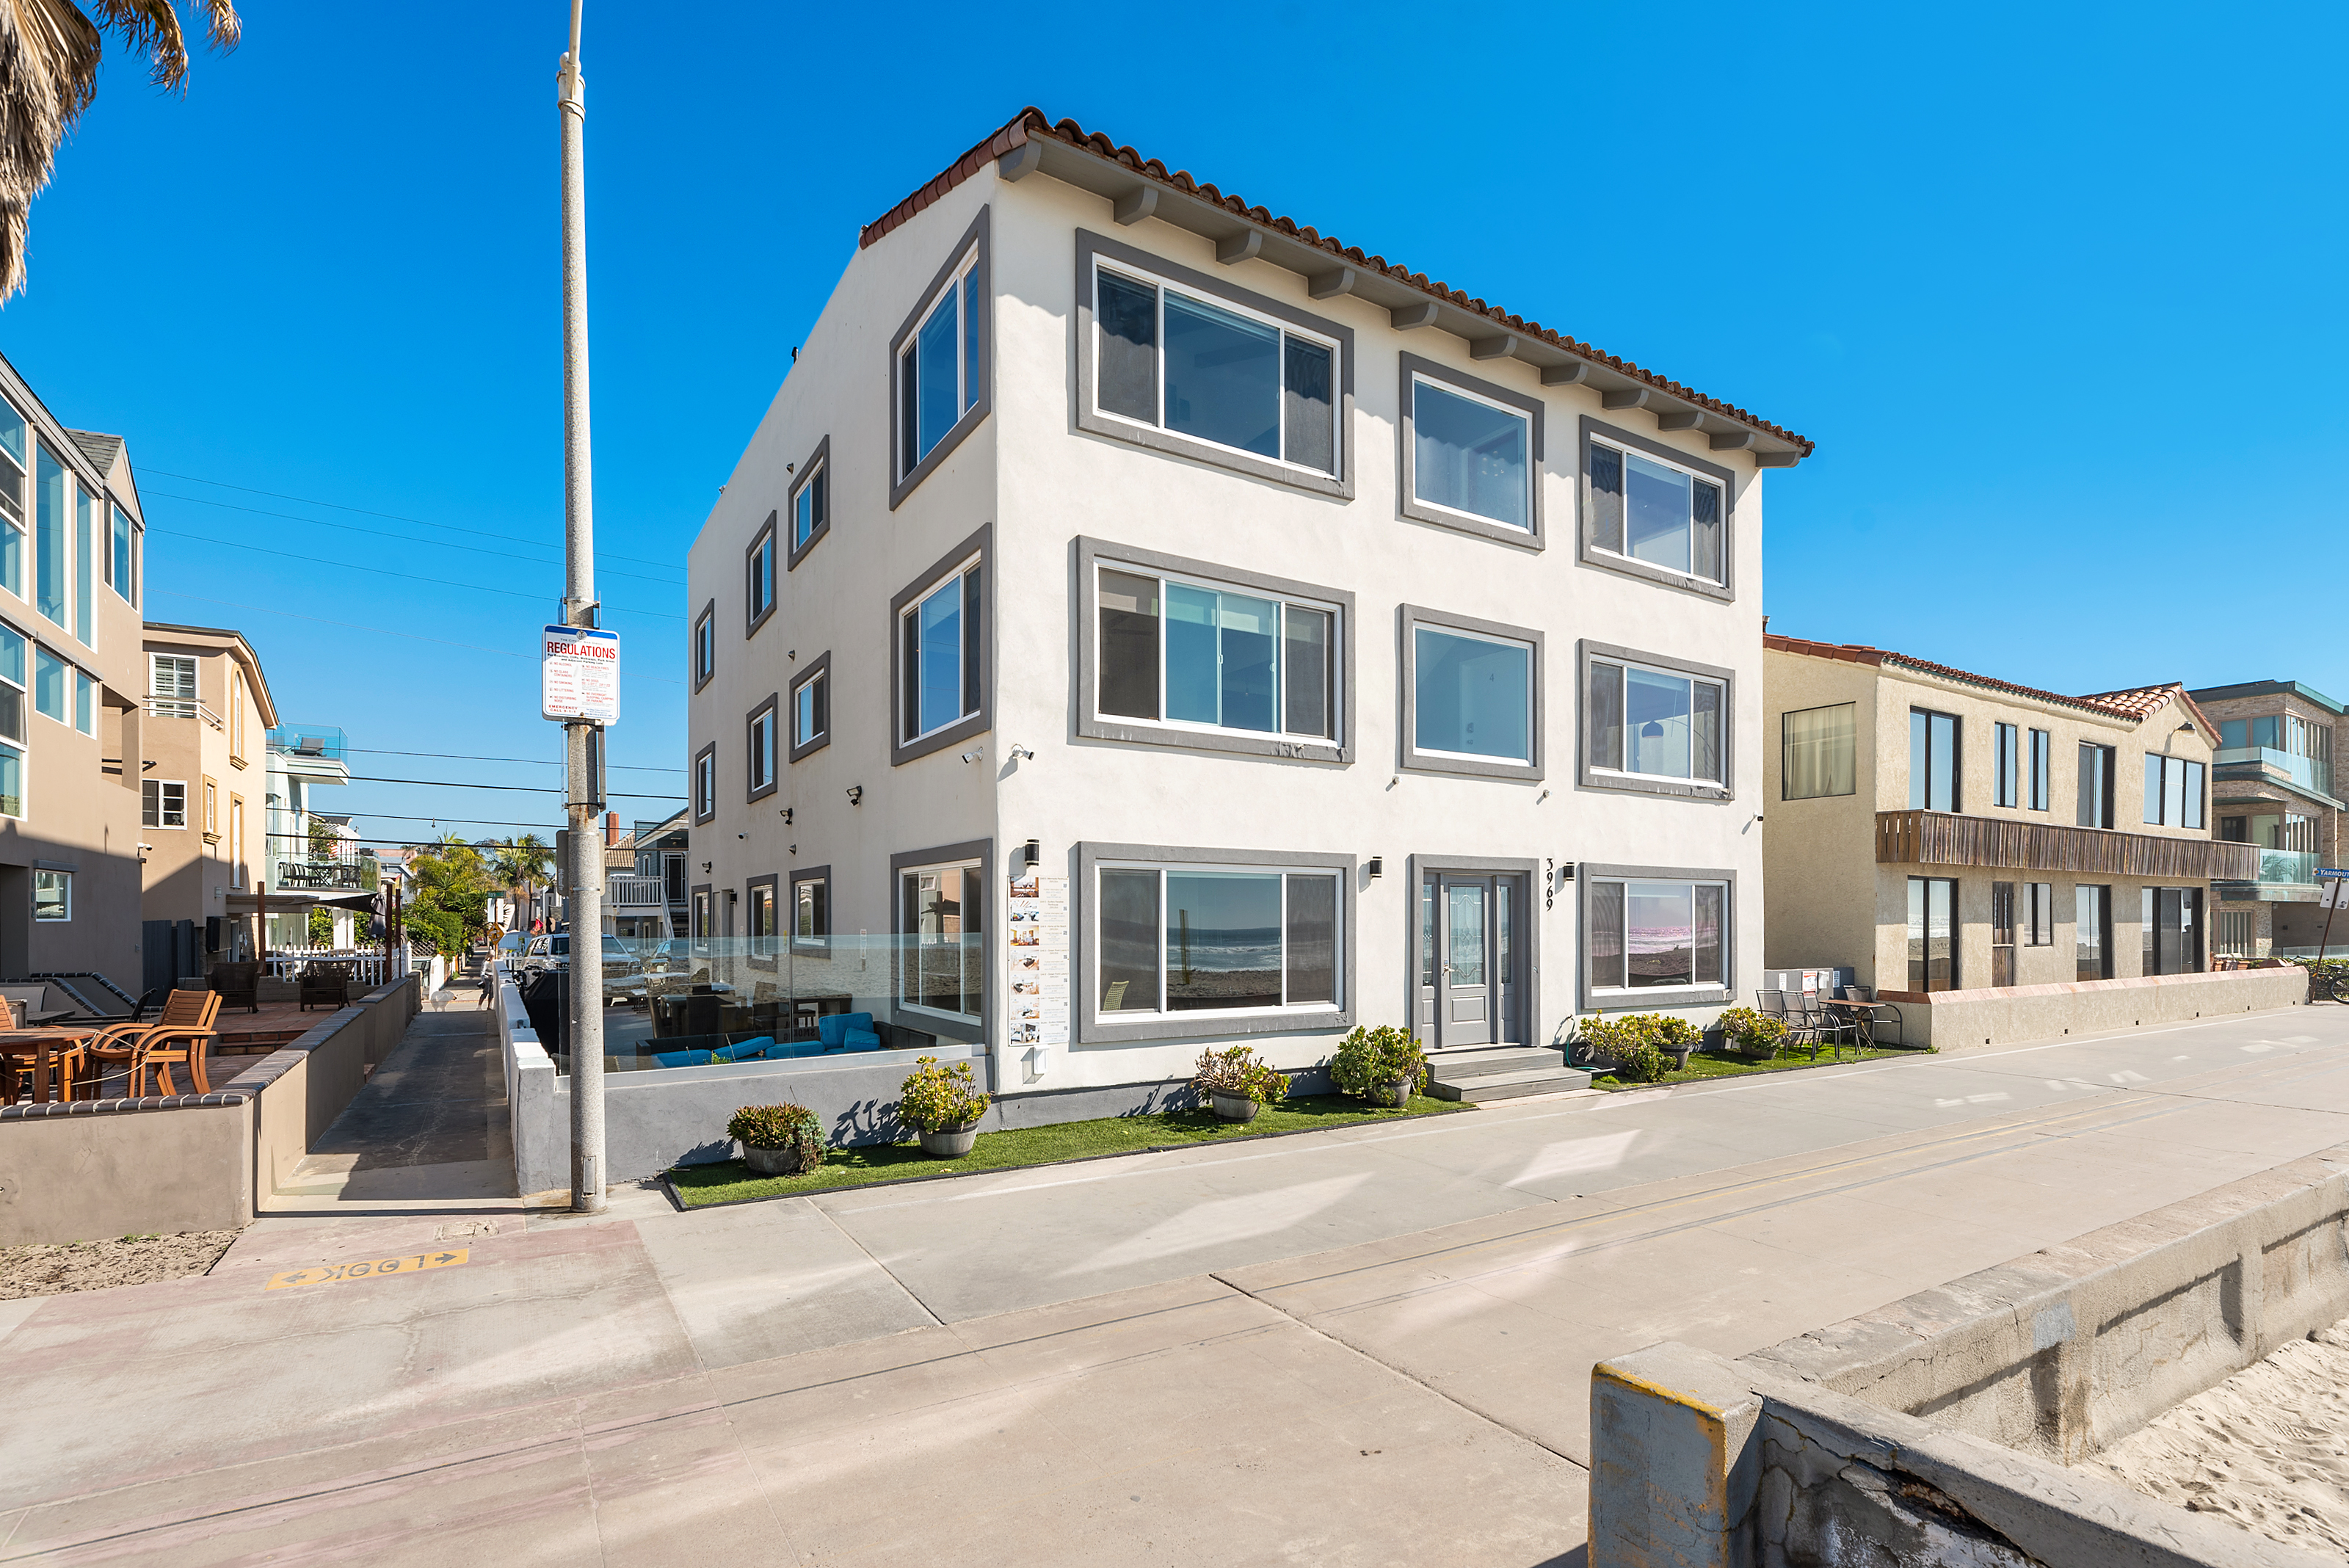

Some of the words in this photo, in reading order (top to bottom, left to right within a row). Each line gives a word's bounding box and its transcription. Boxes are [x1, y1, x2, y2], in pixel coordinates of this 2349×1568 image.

[547, 641, 615, 659] REGULATIONS
[1489, 673, 1494, 682] 4
[317, 1255, 425, 1281] LOOK
